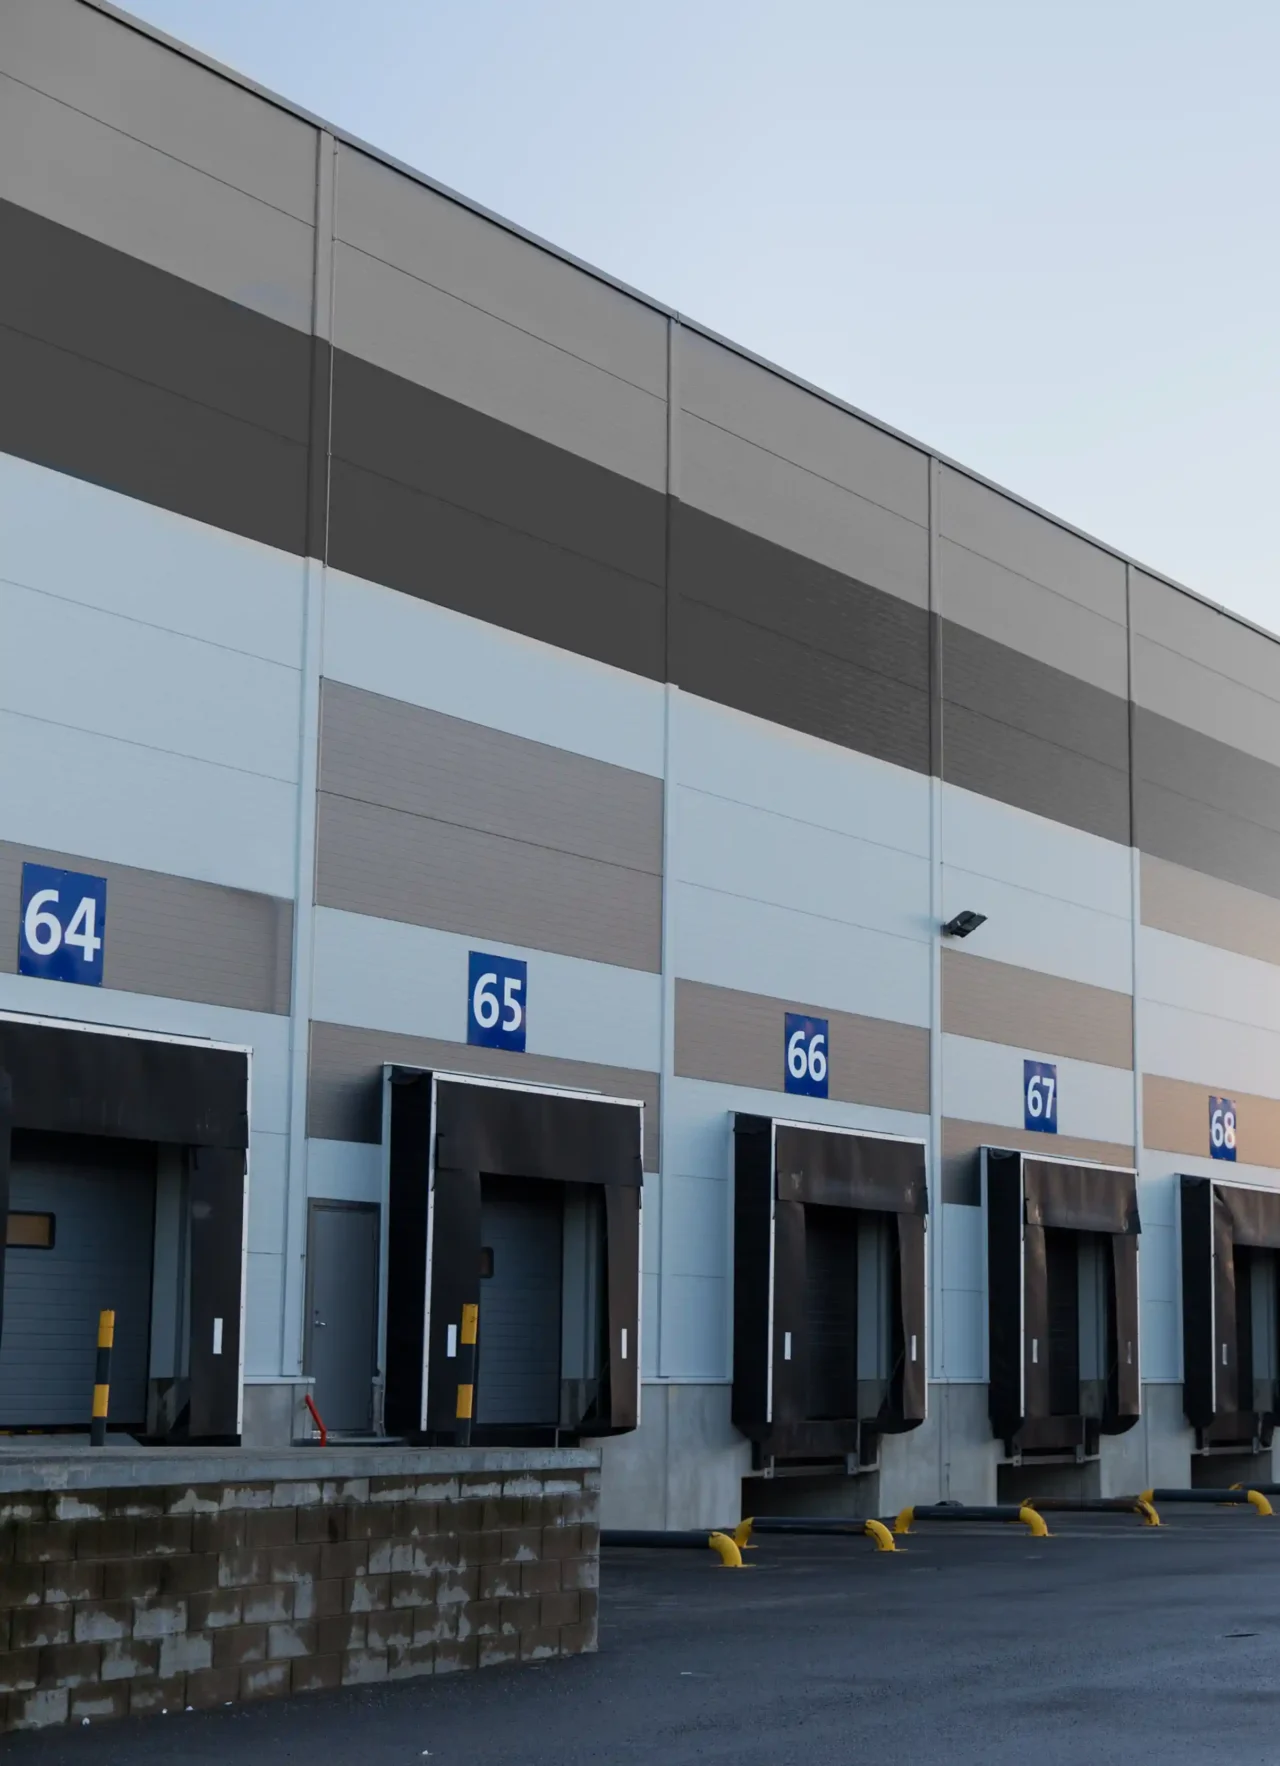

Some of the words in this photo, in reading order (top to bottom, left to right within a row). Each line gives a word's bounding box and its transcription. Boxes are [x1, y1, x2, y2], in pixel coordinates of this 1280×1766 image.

[24, 889, 101, 962] 64
[473, 973, 522, 1031] 65
[787, 1030, 827, 1082] 66
[1027, 1074, 1055, 1119] 67
[1211, 1109, 1236, 1149] 68
